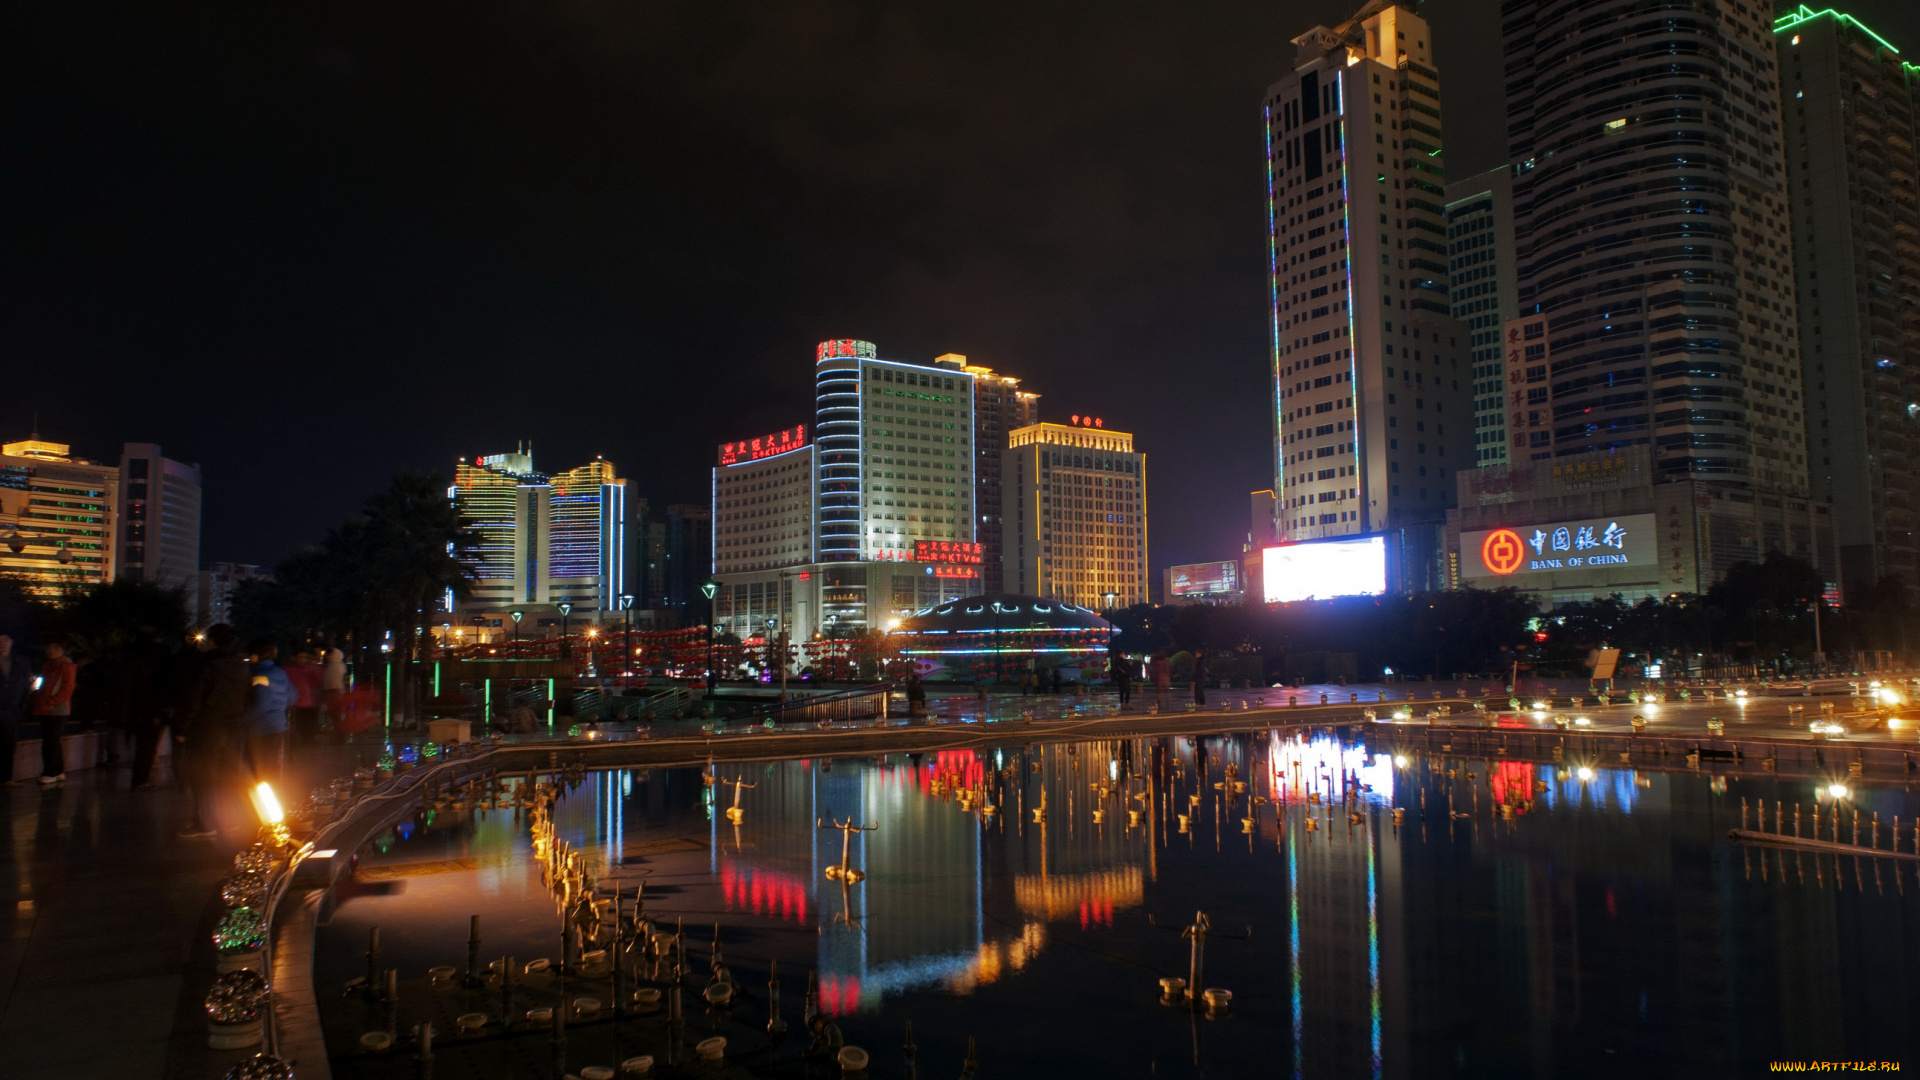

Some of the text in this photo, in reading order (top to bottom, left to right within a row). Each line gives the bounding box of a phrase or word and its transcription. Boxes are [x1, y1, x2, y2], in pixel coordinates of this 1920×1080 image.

[738, 424, 804, 455] 皇冠大酒店
[930, 541, 981, 554] 皇冠大酒店
[1530, 554, 1629, 570] BANK OF CHINA
